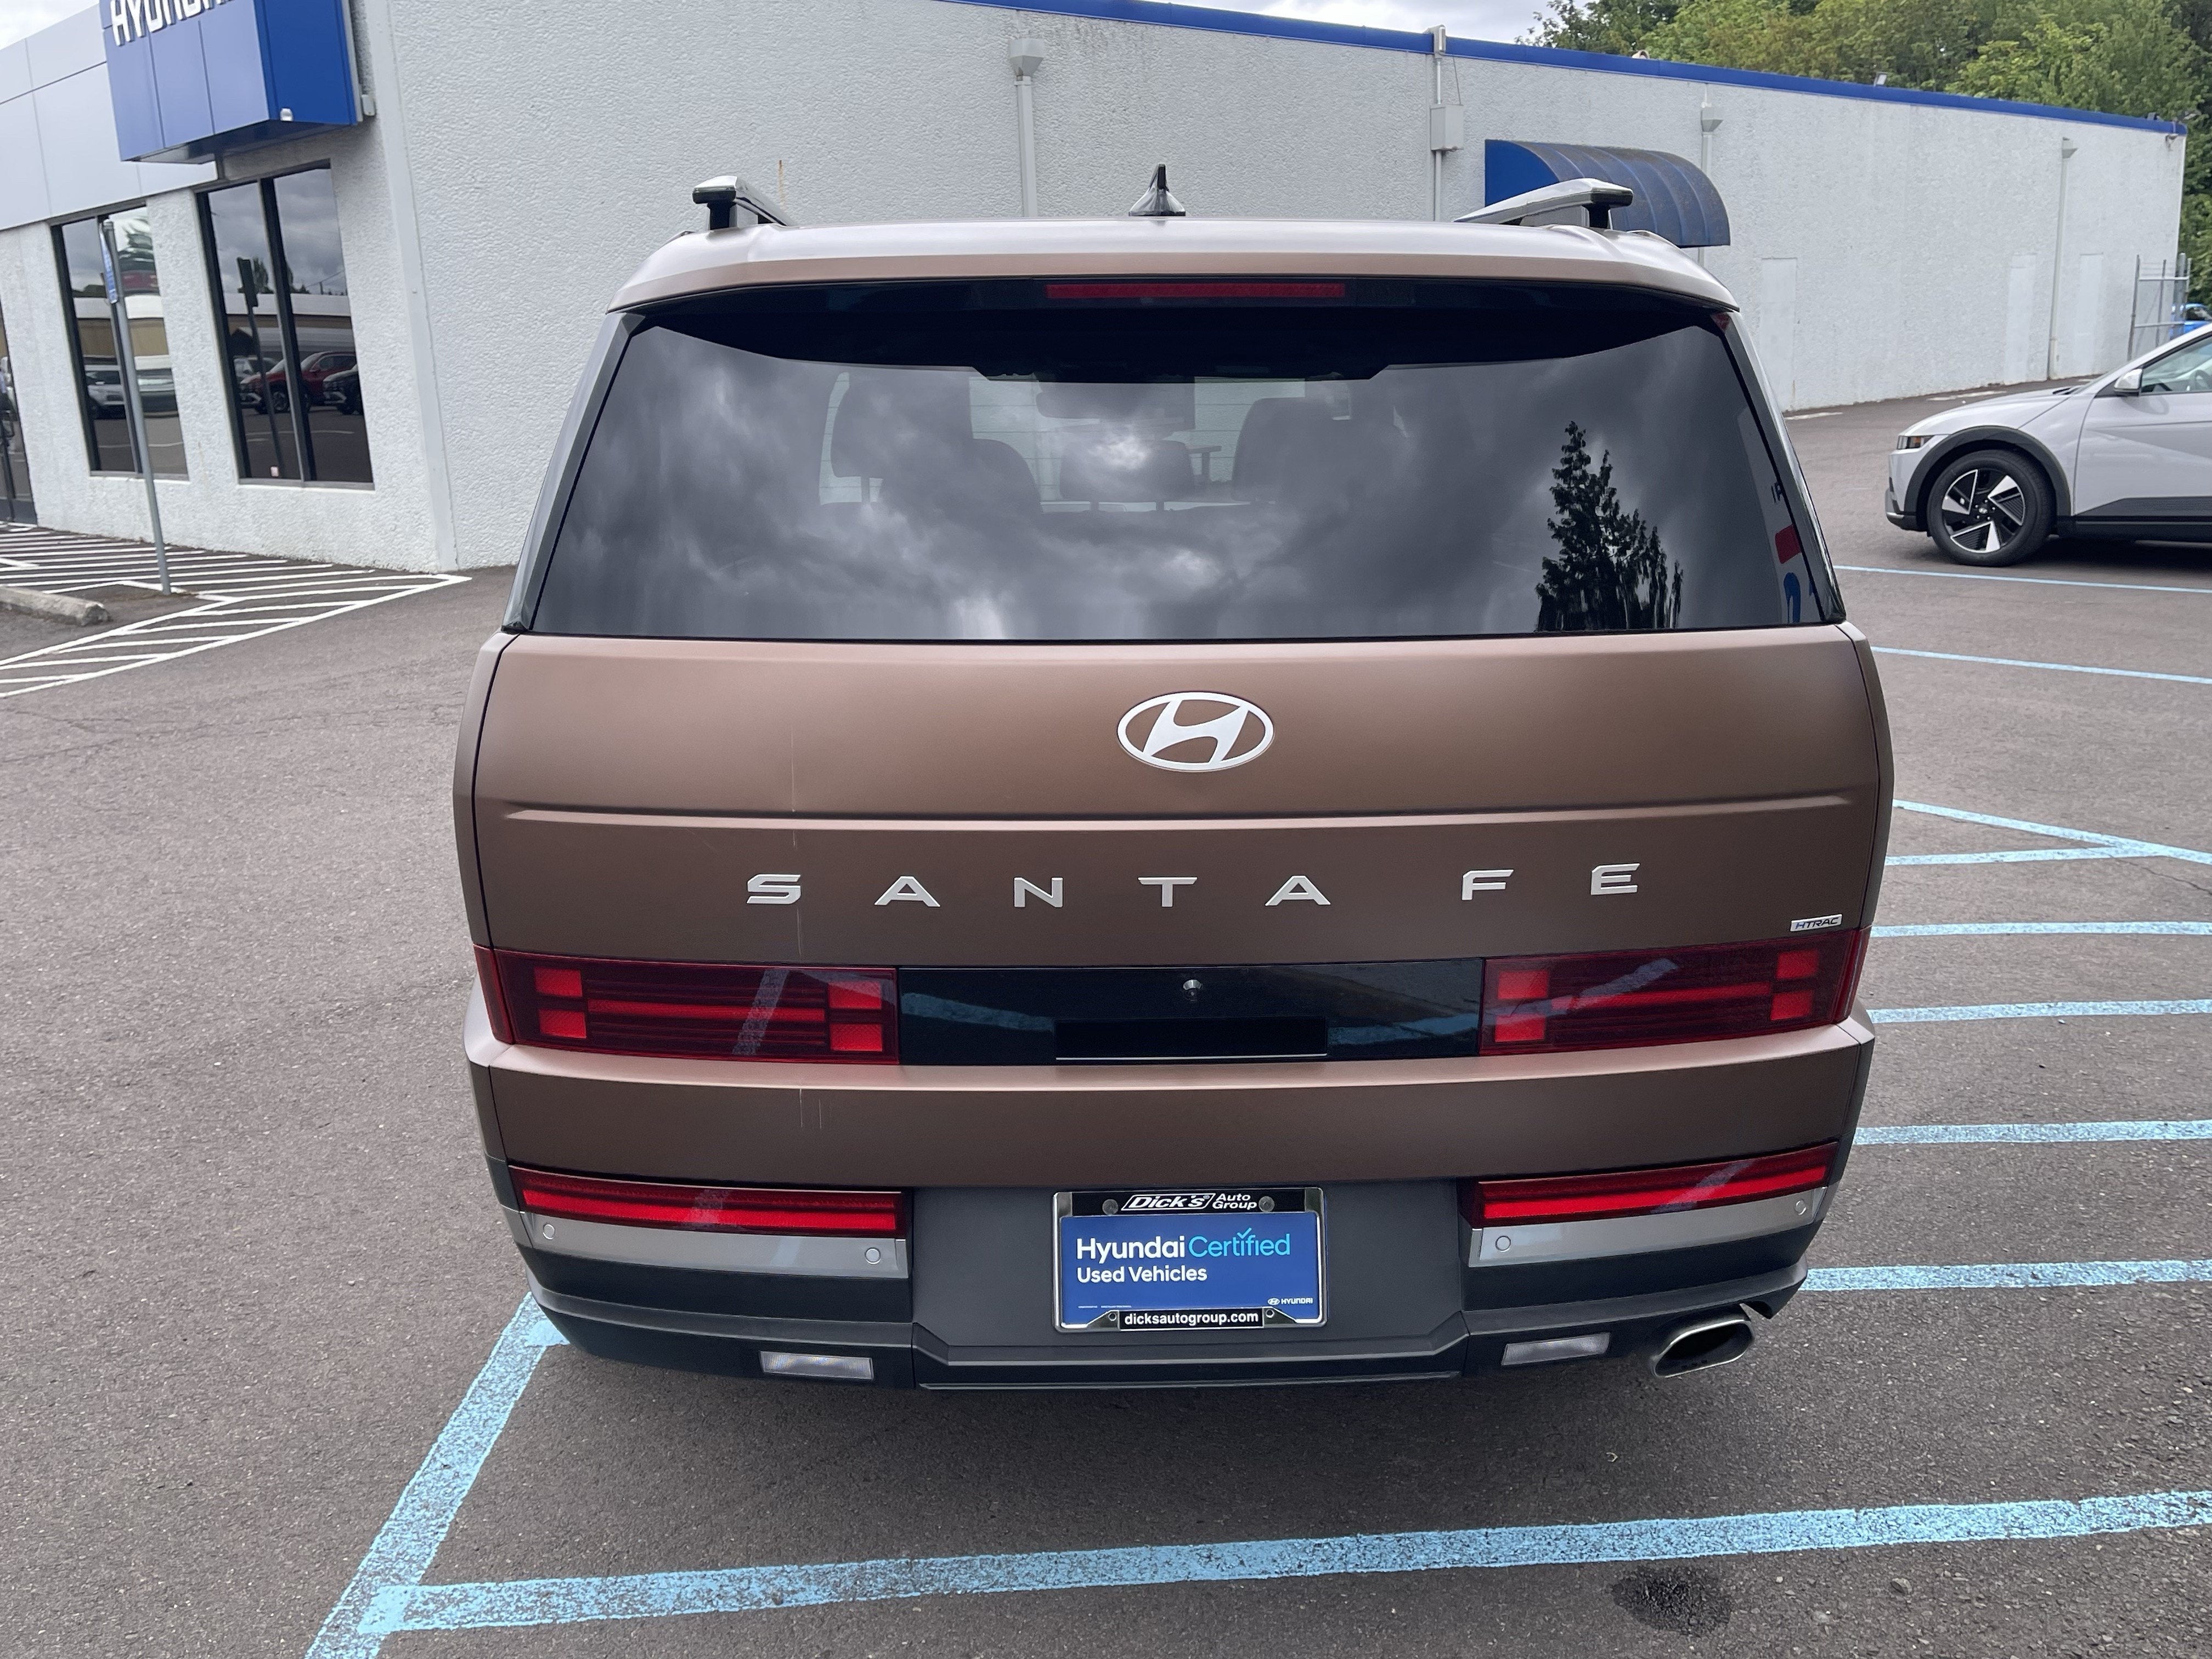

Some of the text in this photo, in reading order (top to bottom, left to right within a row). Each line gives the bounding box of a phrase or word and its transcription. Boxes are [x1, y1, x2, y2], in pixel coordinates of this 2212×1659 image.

[747, 863, 1640, 908] SANTA FE
[1795, 917, 1839, 929] HTRAC
[1128, 1195, 1205, 1209] Dick's
[1216, 1193, 1251, 1201] Auto
[1212, 1201, 1257, 1210] Group
[1076, 1228, 1291, 1264] Hyundai Certified
[1077, 1265, 1207, 1283] Used Vehicles
[1125, 1312, 1259, 1326] dicksautogroup.com
